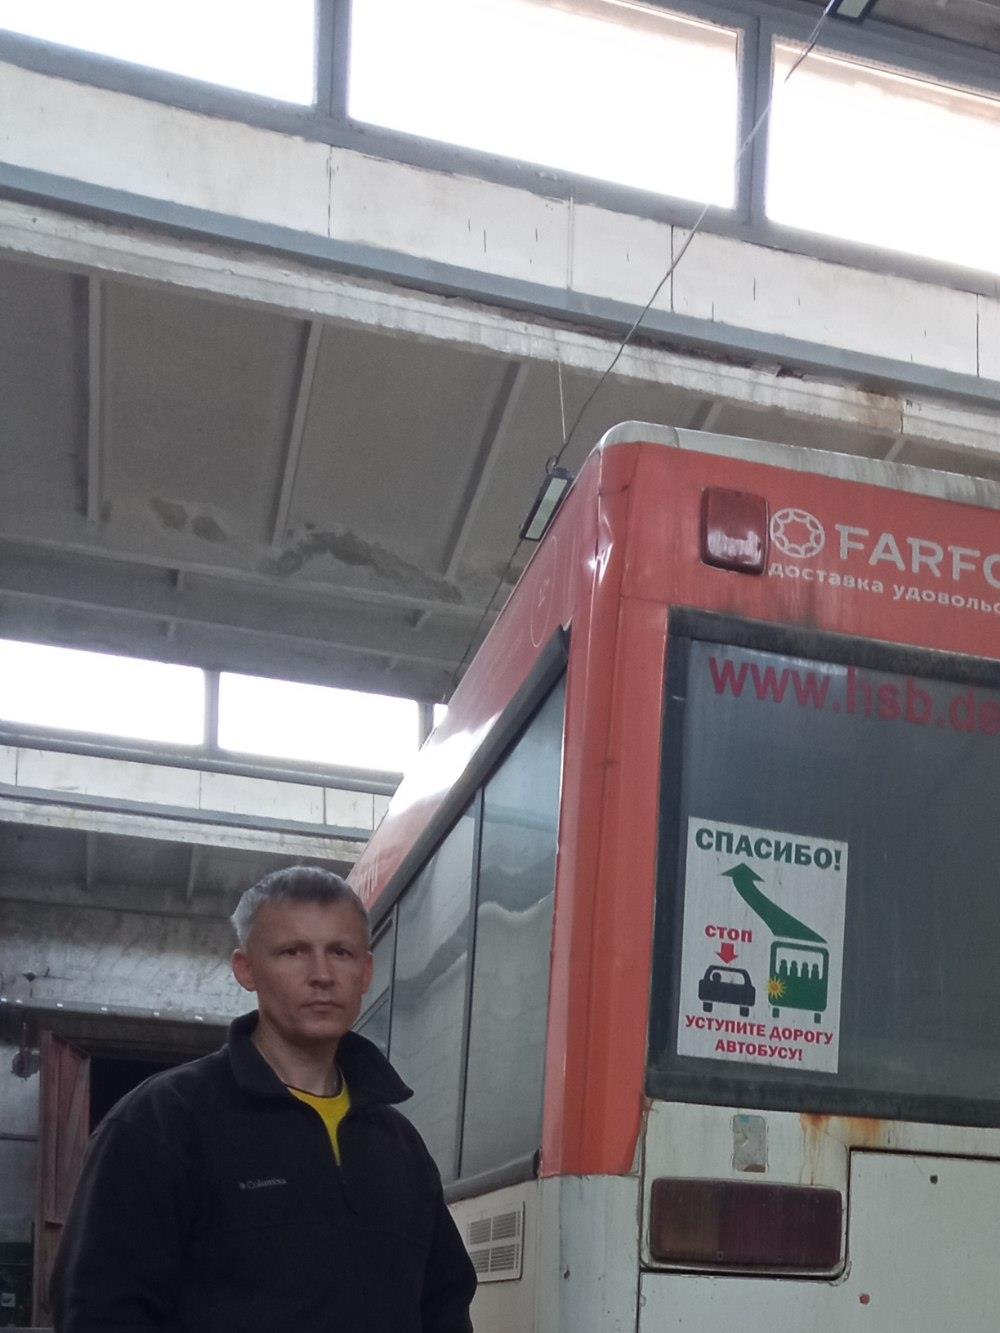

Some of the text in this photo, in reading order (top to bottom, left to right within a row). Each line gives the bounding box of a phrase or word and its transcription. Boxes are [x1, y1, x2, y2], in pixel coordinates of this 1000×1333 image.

[768, 561, 884, 594] доставка
[695, 827, 843, 872] СПАСИБО!
[685, 1014, 834, 1045] УСТУПИТЕ ДОРОГУ
[715, 1039, 803, 1061] АВТОБУСУ!
